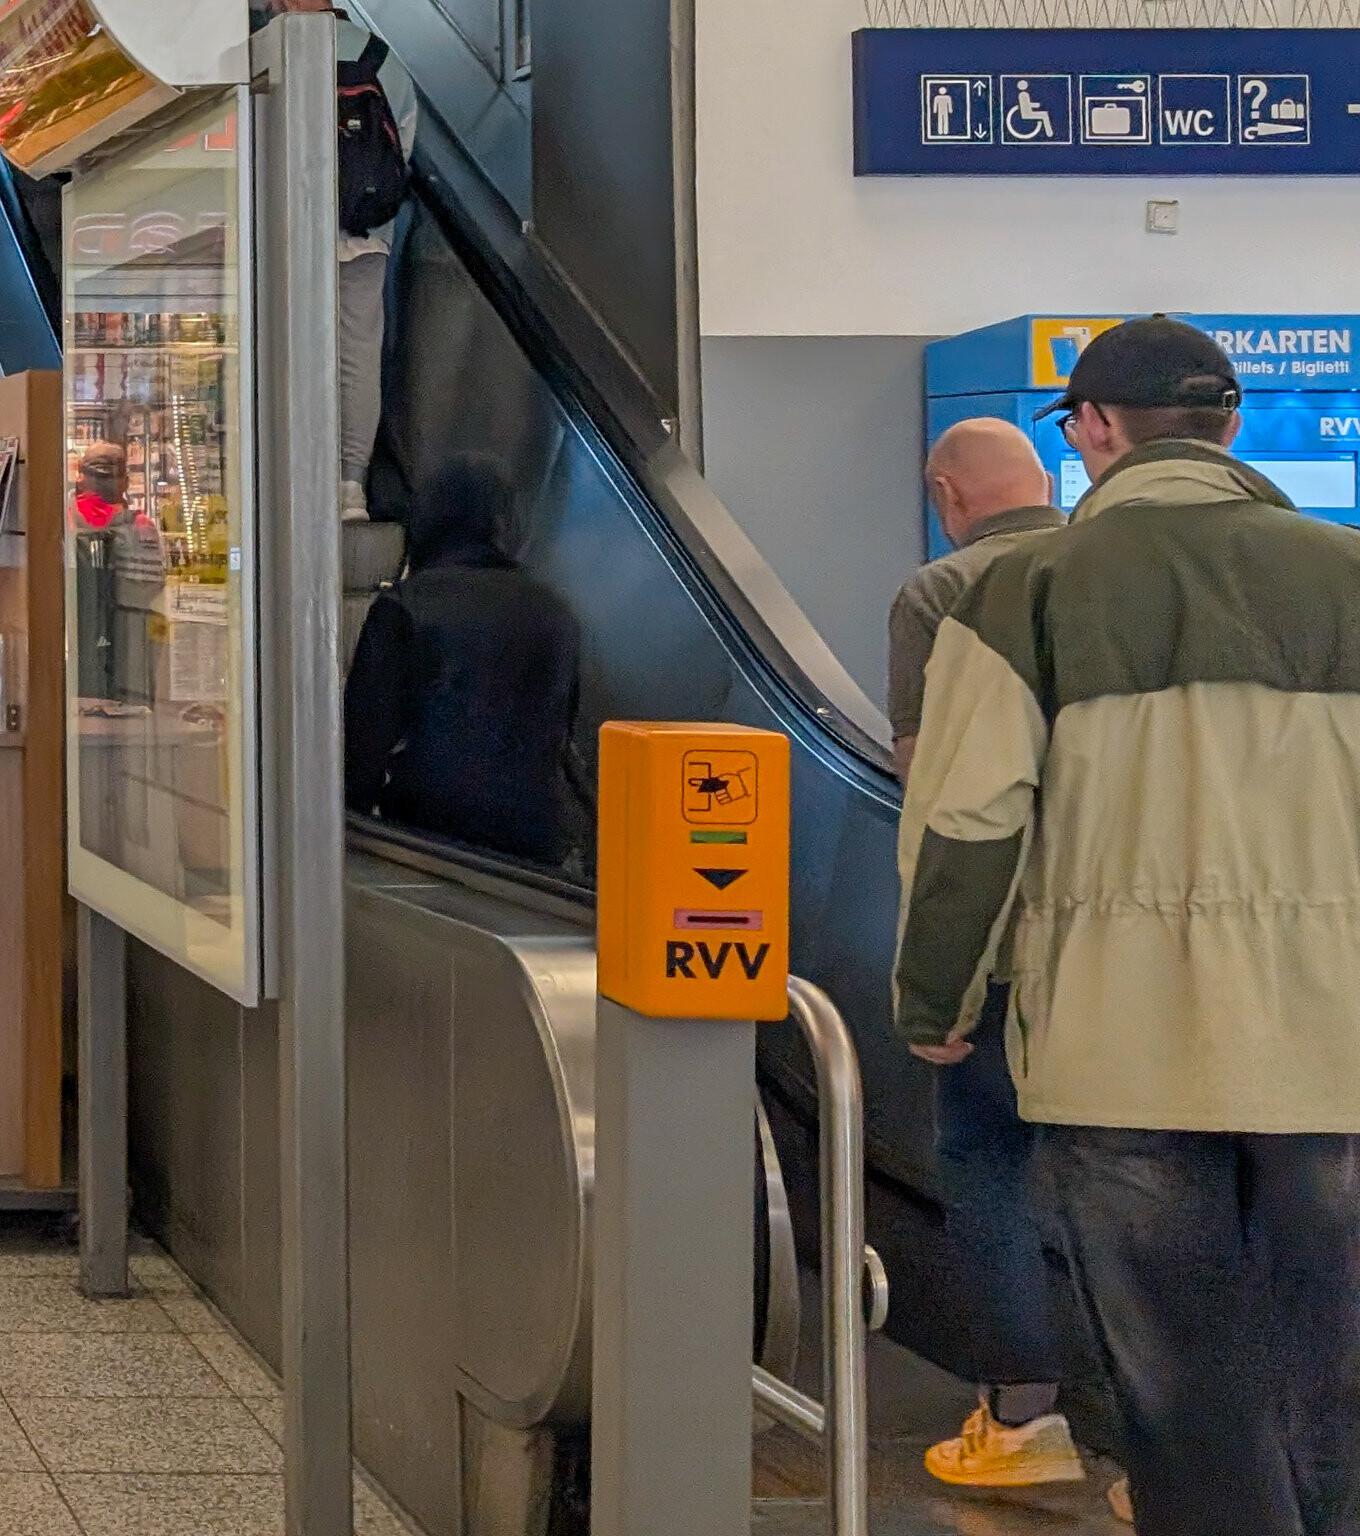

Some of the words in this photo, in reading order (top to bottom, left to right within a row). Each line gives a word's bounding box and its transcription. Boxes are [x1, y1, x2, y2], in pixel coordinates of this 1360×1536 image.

[1164, 110, 1215, 136] WC
[1206, 330, 1351, 355] RKARTEN
[1292, 361, 1350, 377] Biglietti
[665, 940, 770, 980] RVV
